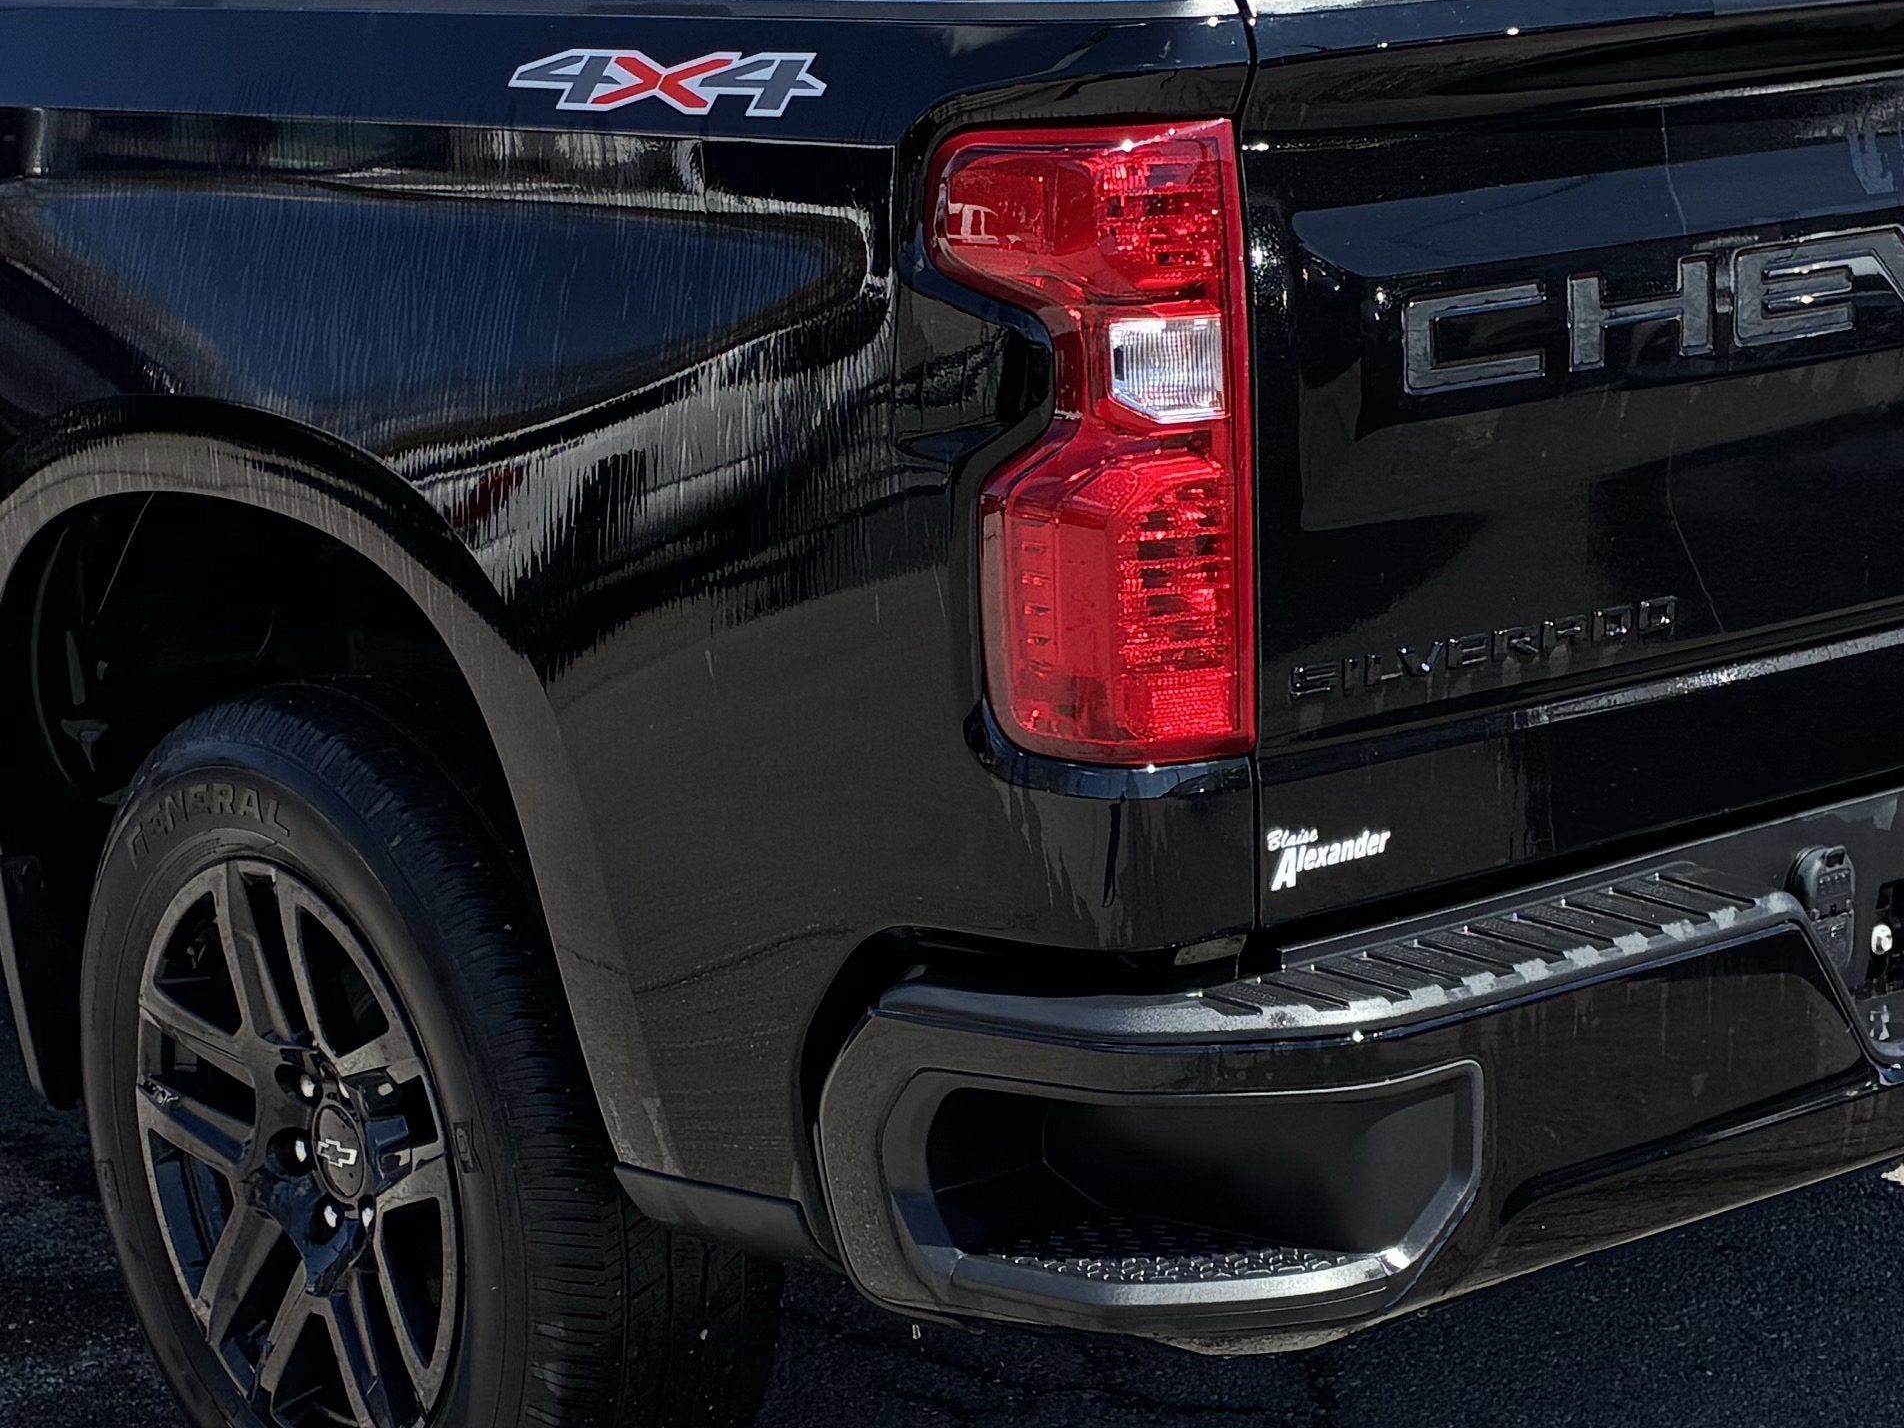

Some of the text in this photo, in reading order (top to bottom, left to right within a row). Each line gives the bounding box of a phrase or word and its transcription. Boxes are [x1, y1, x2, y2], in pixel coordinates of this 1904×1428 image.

[1289, 594, 1680, 700] SILVERADO
[1267, 828, 1319, 852] Blaise
[1270, 828, 1392, 892] Alexander
